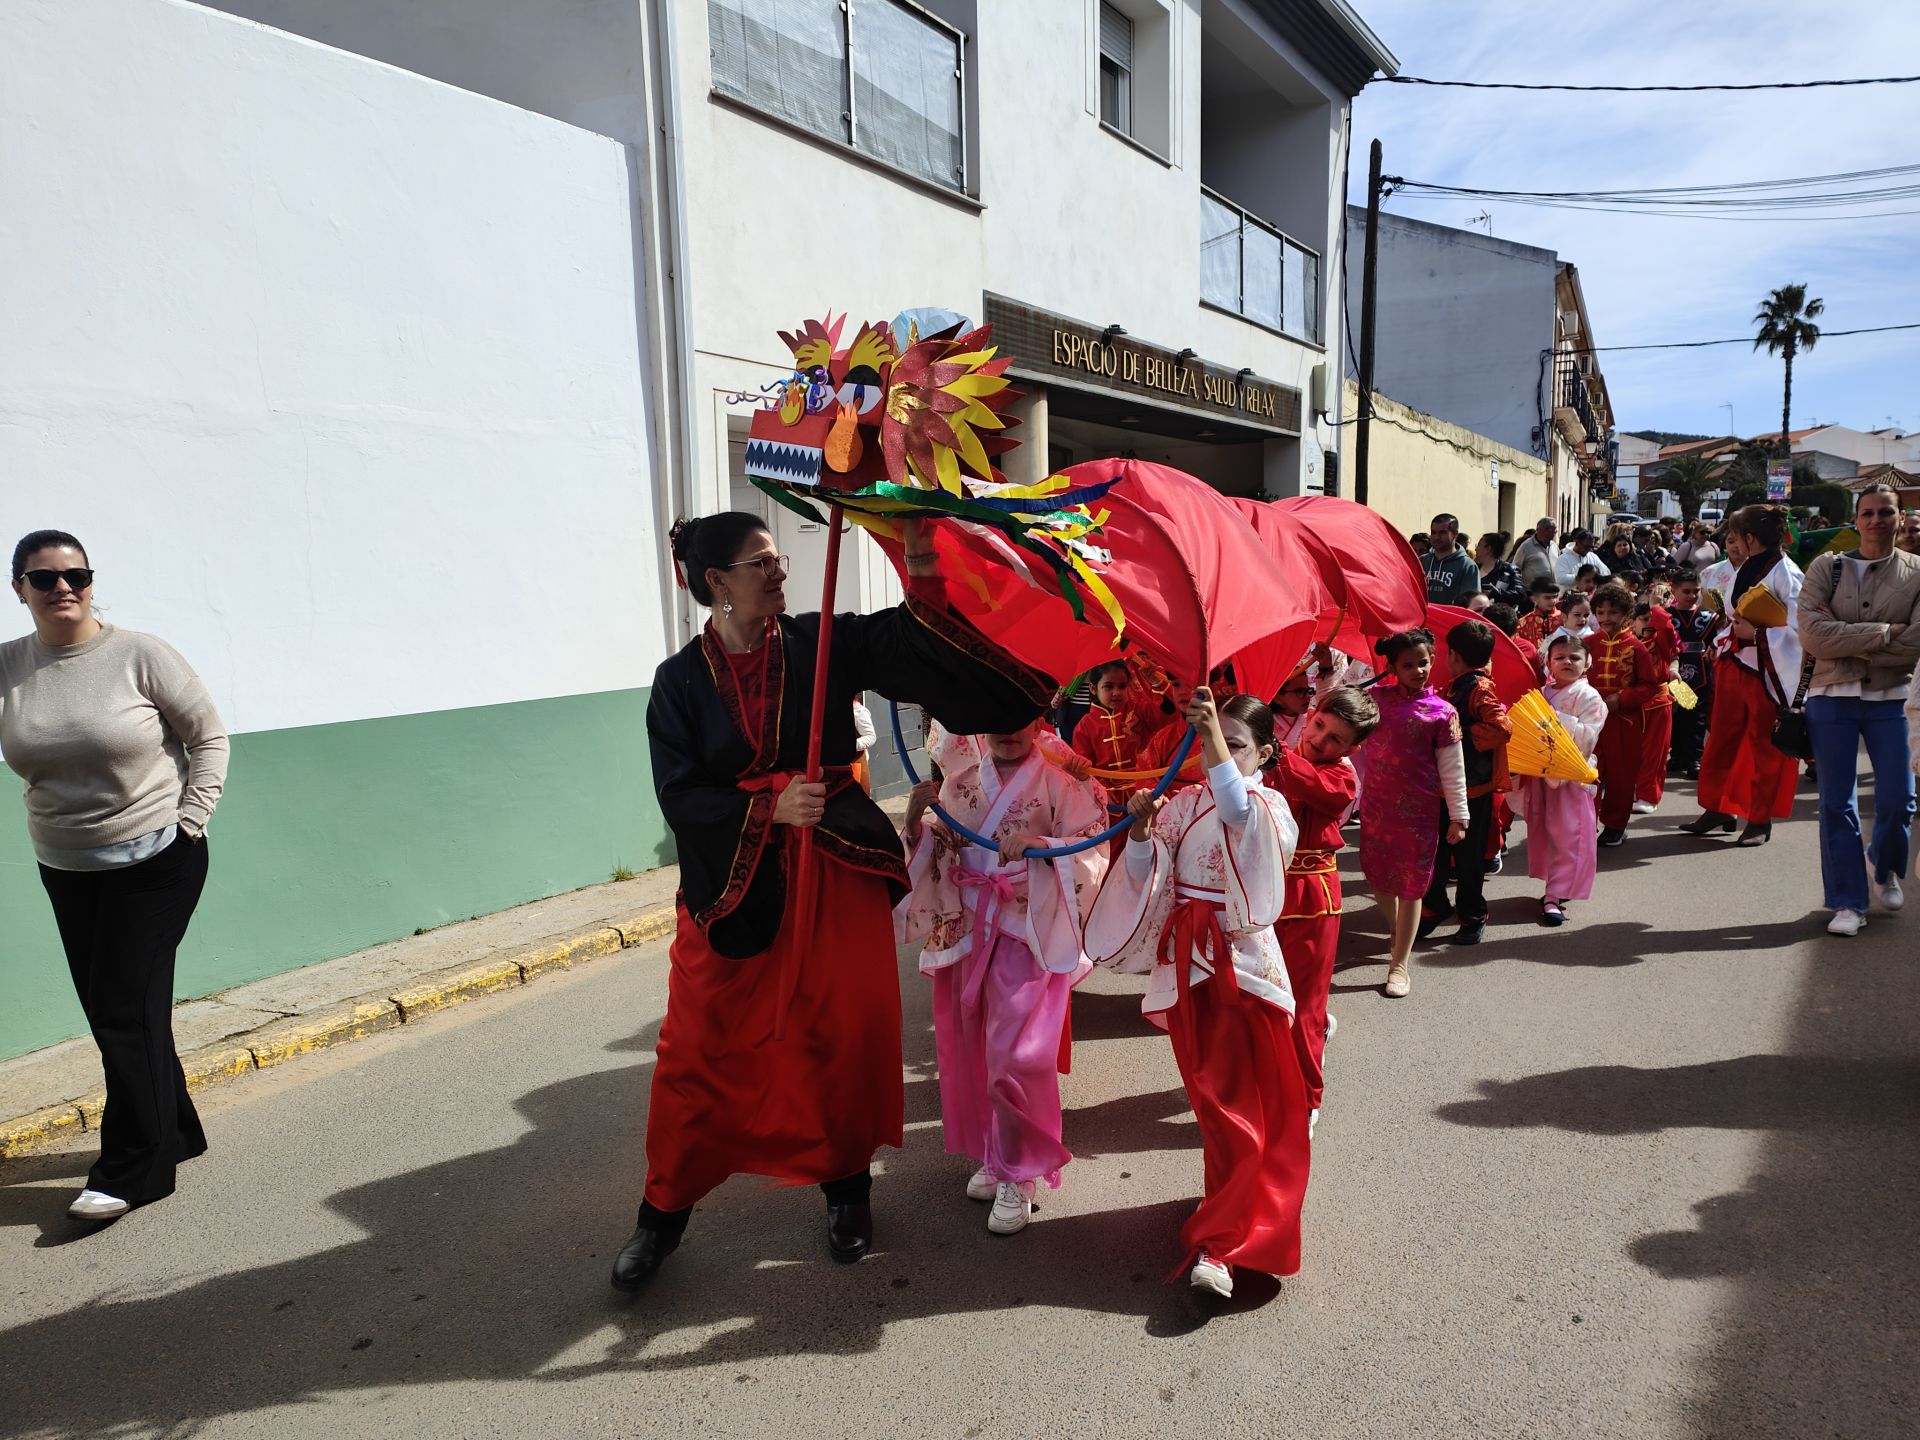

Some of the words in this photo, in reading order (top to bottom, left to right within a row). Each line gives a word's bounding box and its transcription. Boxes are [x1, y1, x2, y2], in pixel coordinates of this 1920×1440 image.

[1054, 329, 1117, 376] ESPACIO
[1123, 349, 1140, 383] DE
[1146, 356, 1200, 401] BELLEZA,
[1203, 374, 1237, 407] SALUD
[1238, 384, 1245, 410] Y
[1246, 386, 1276, 417] RELAX
[1426, 570, 1454, 587] ARIS
